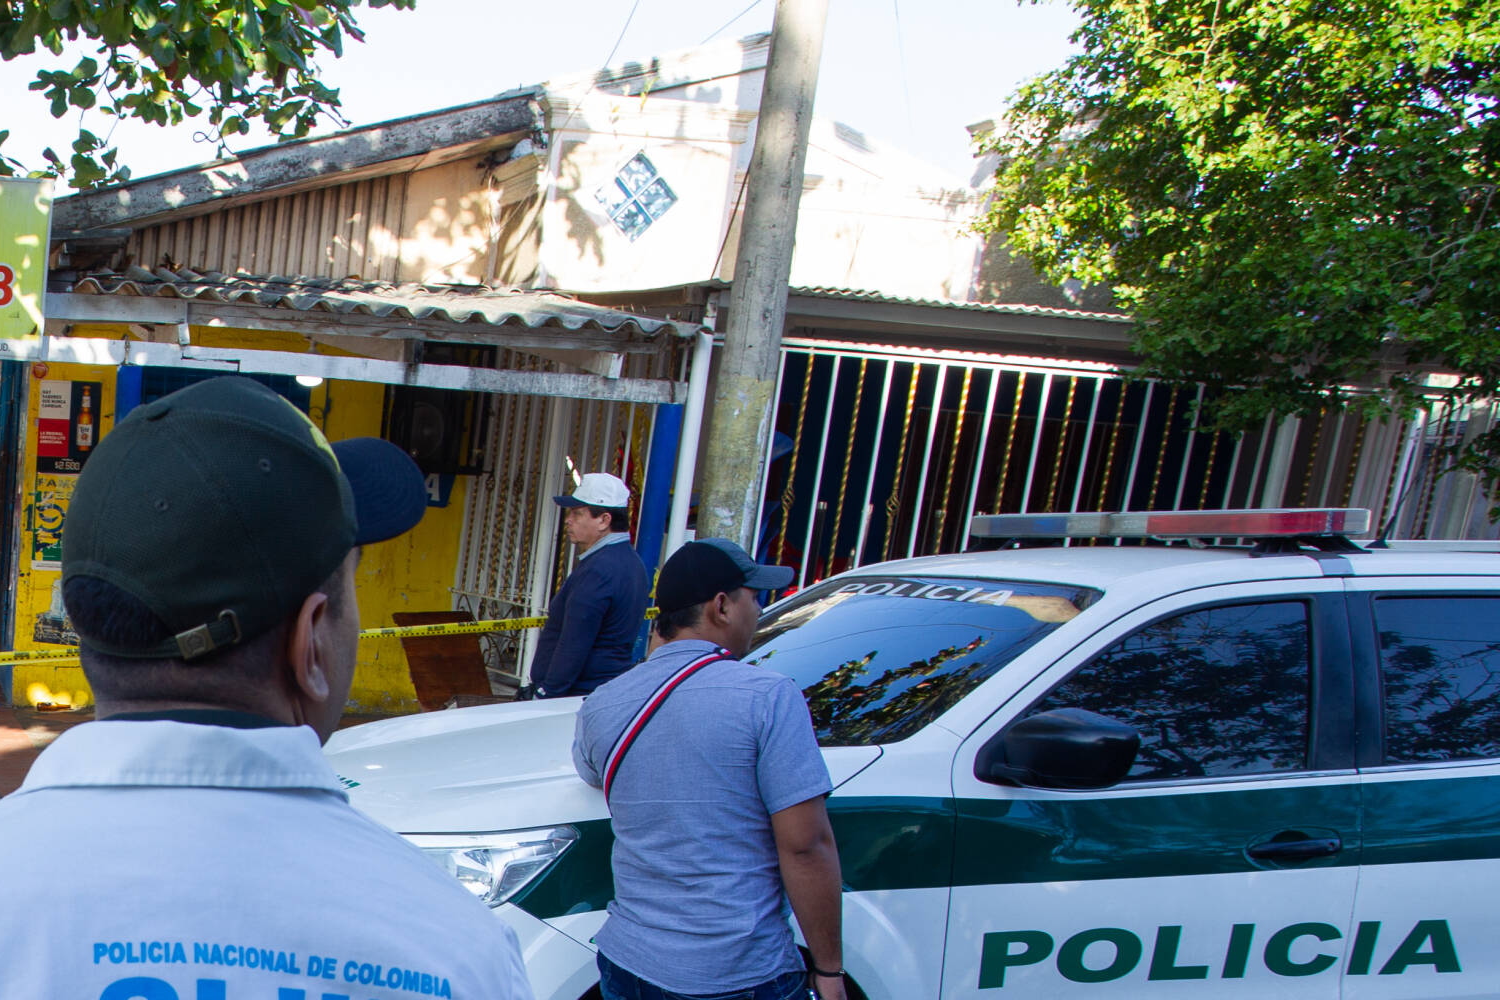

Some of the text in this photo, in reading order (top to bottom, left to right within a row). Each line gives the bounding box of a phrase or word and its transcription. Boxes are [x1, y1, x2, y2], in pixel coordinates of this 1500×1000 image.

[828, 582, 1014, 606] POLICIA
[93, 941, 452, 999] POLICIA NACIONAL DE COLOMBIA
[978, 919, 1462, 990] POLICIA
